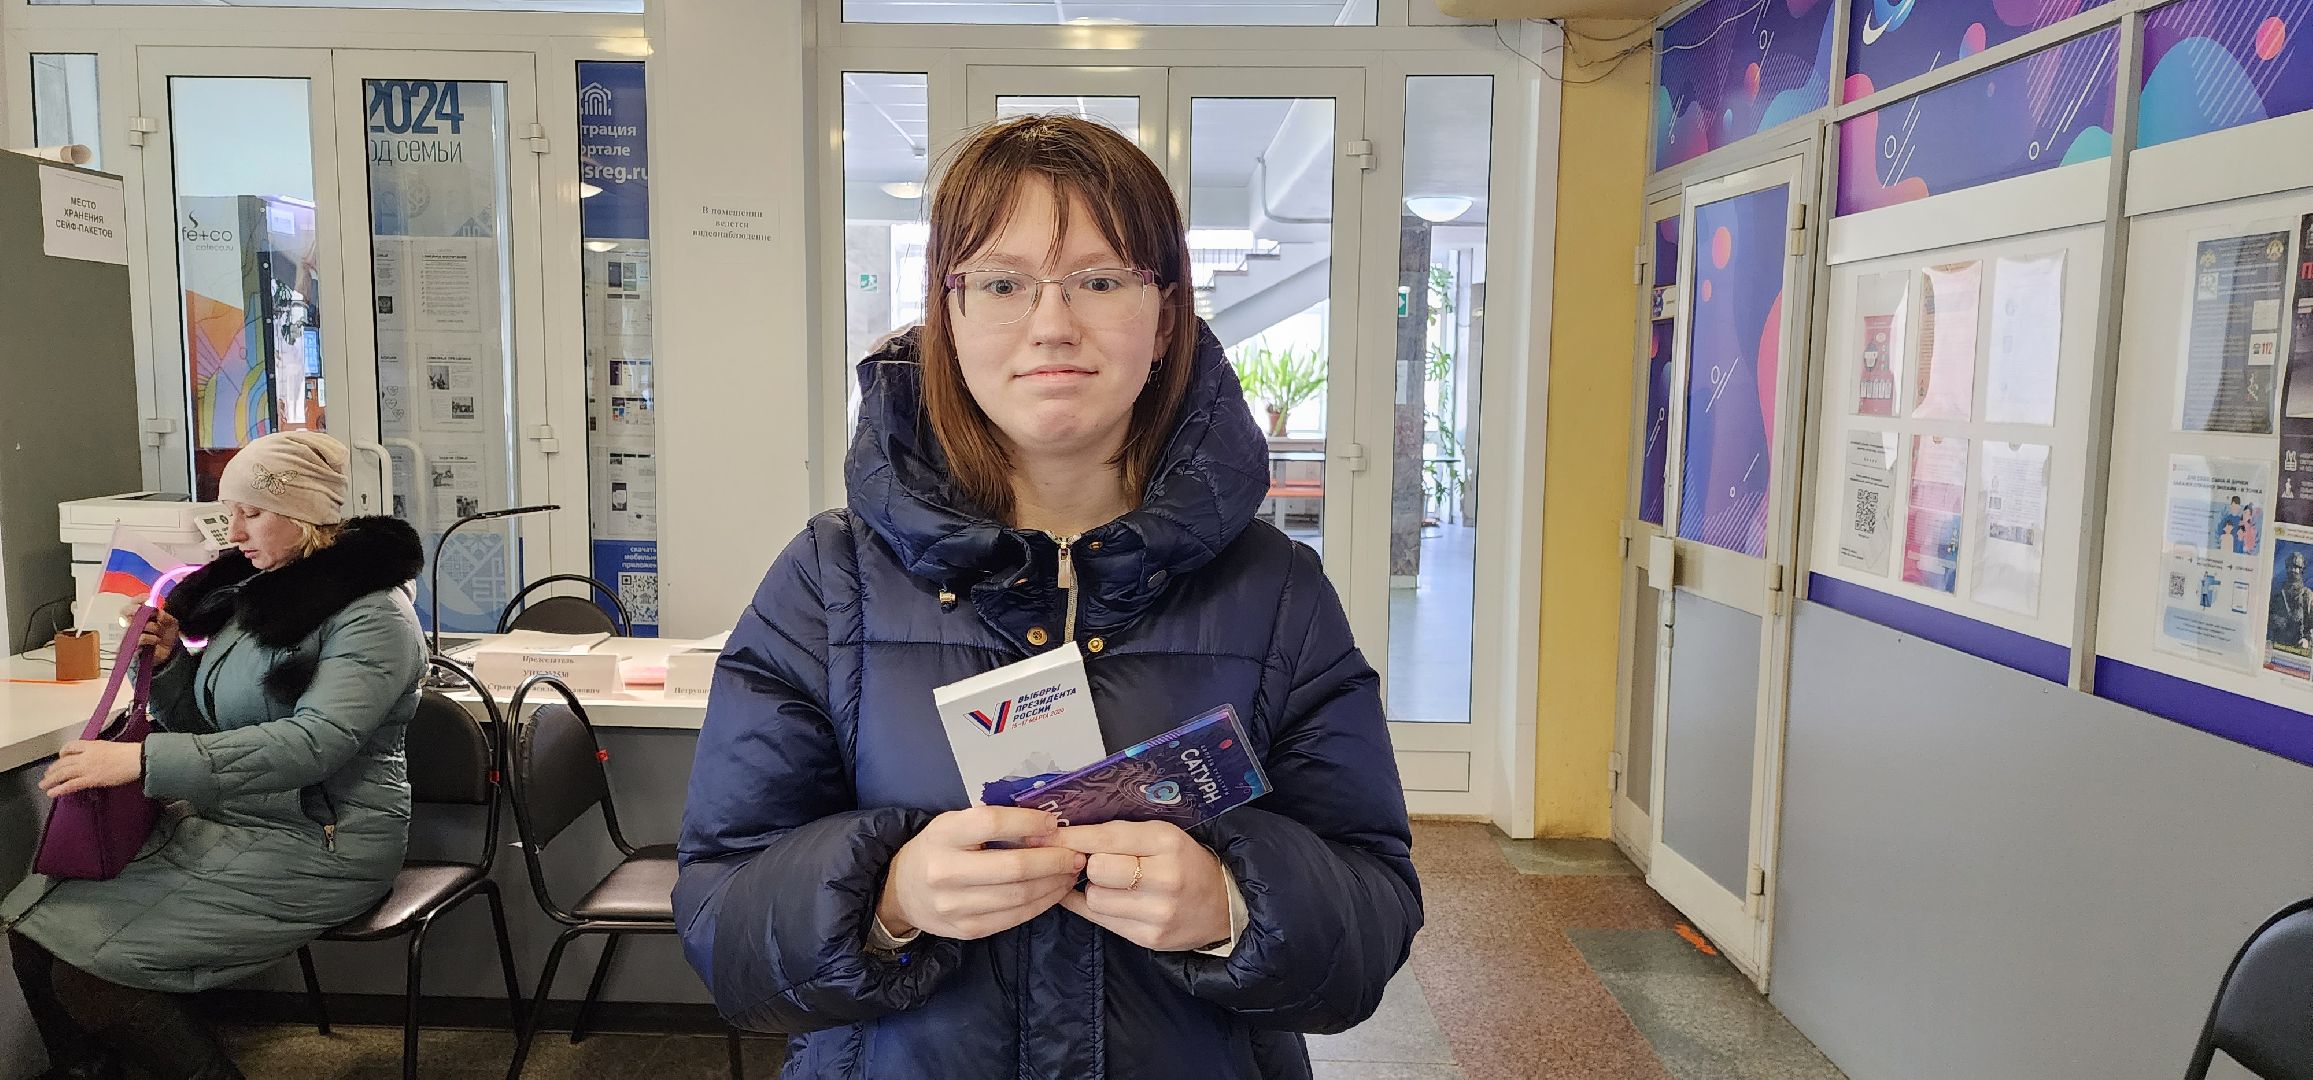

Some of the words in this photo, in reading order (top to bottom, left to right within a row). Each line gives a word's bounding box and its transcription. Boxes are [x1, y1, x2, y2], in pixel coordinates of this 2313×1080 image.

[368, 80, 464, 134] 2024
[397, 140, 462, 163] семьи
[71, 197, 96, 209] МЕСТО
[64, 208, 104, 223] ХРАНЕНИЯ
[702, 205, 709, 214] В
[711, 208, 763, 218] помещении
[56, 220, 113, 238] СЕЙФ-ПАКЕТОВ
[692, 230, 772, 241] видеонаблюдение
[2262, 342, 2273, 355] 112
[522, 655, 575, 664] Председатель
[1015, 688, 1077, 712] ПРЕЗИДЕНТА
[1018, 684, 1061, 703] ВЫБОРЫ
[1013, 704, 1052, 722] РОССИИ
[1028, 714, 1049, 724] МАРТА
[1180, 748, 1222, 804] САТУРН
